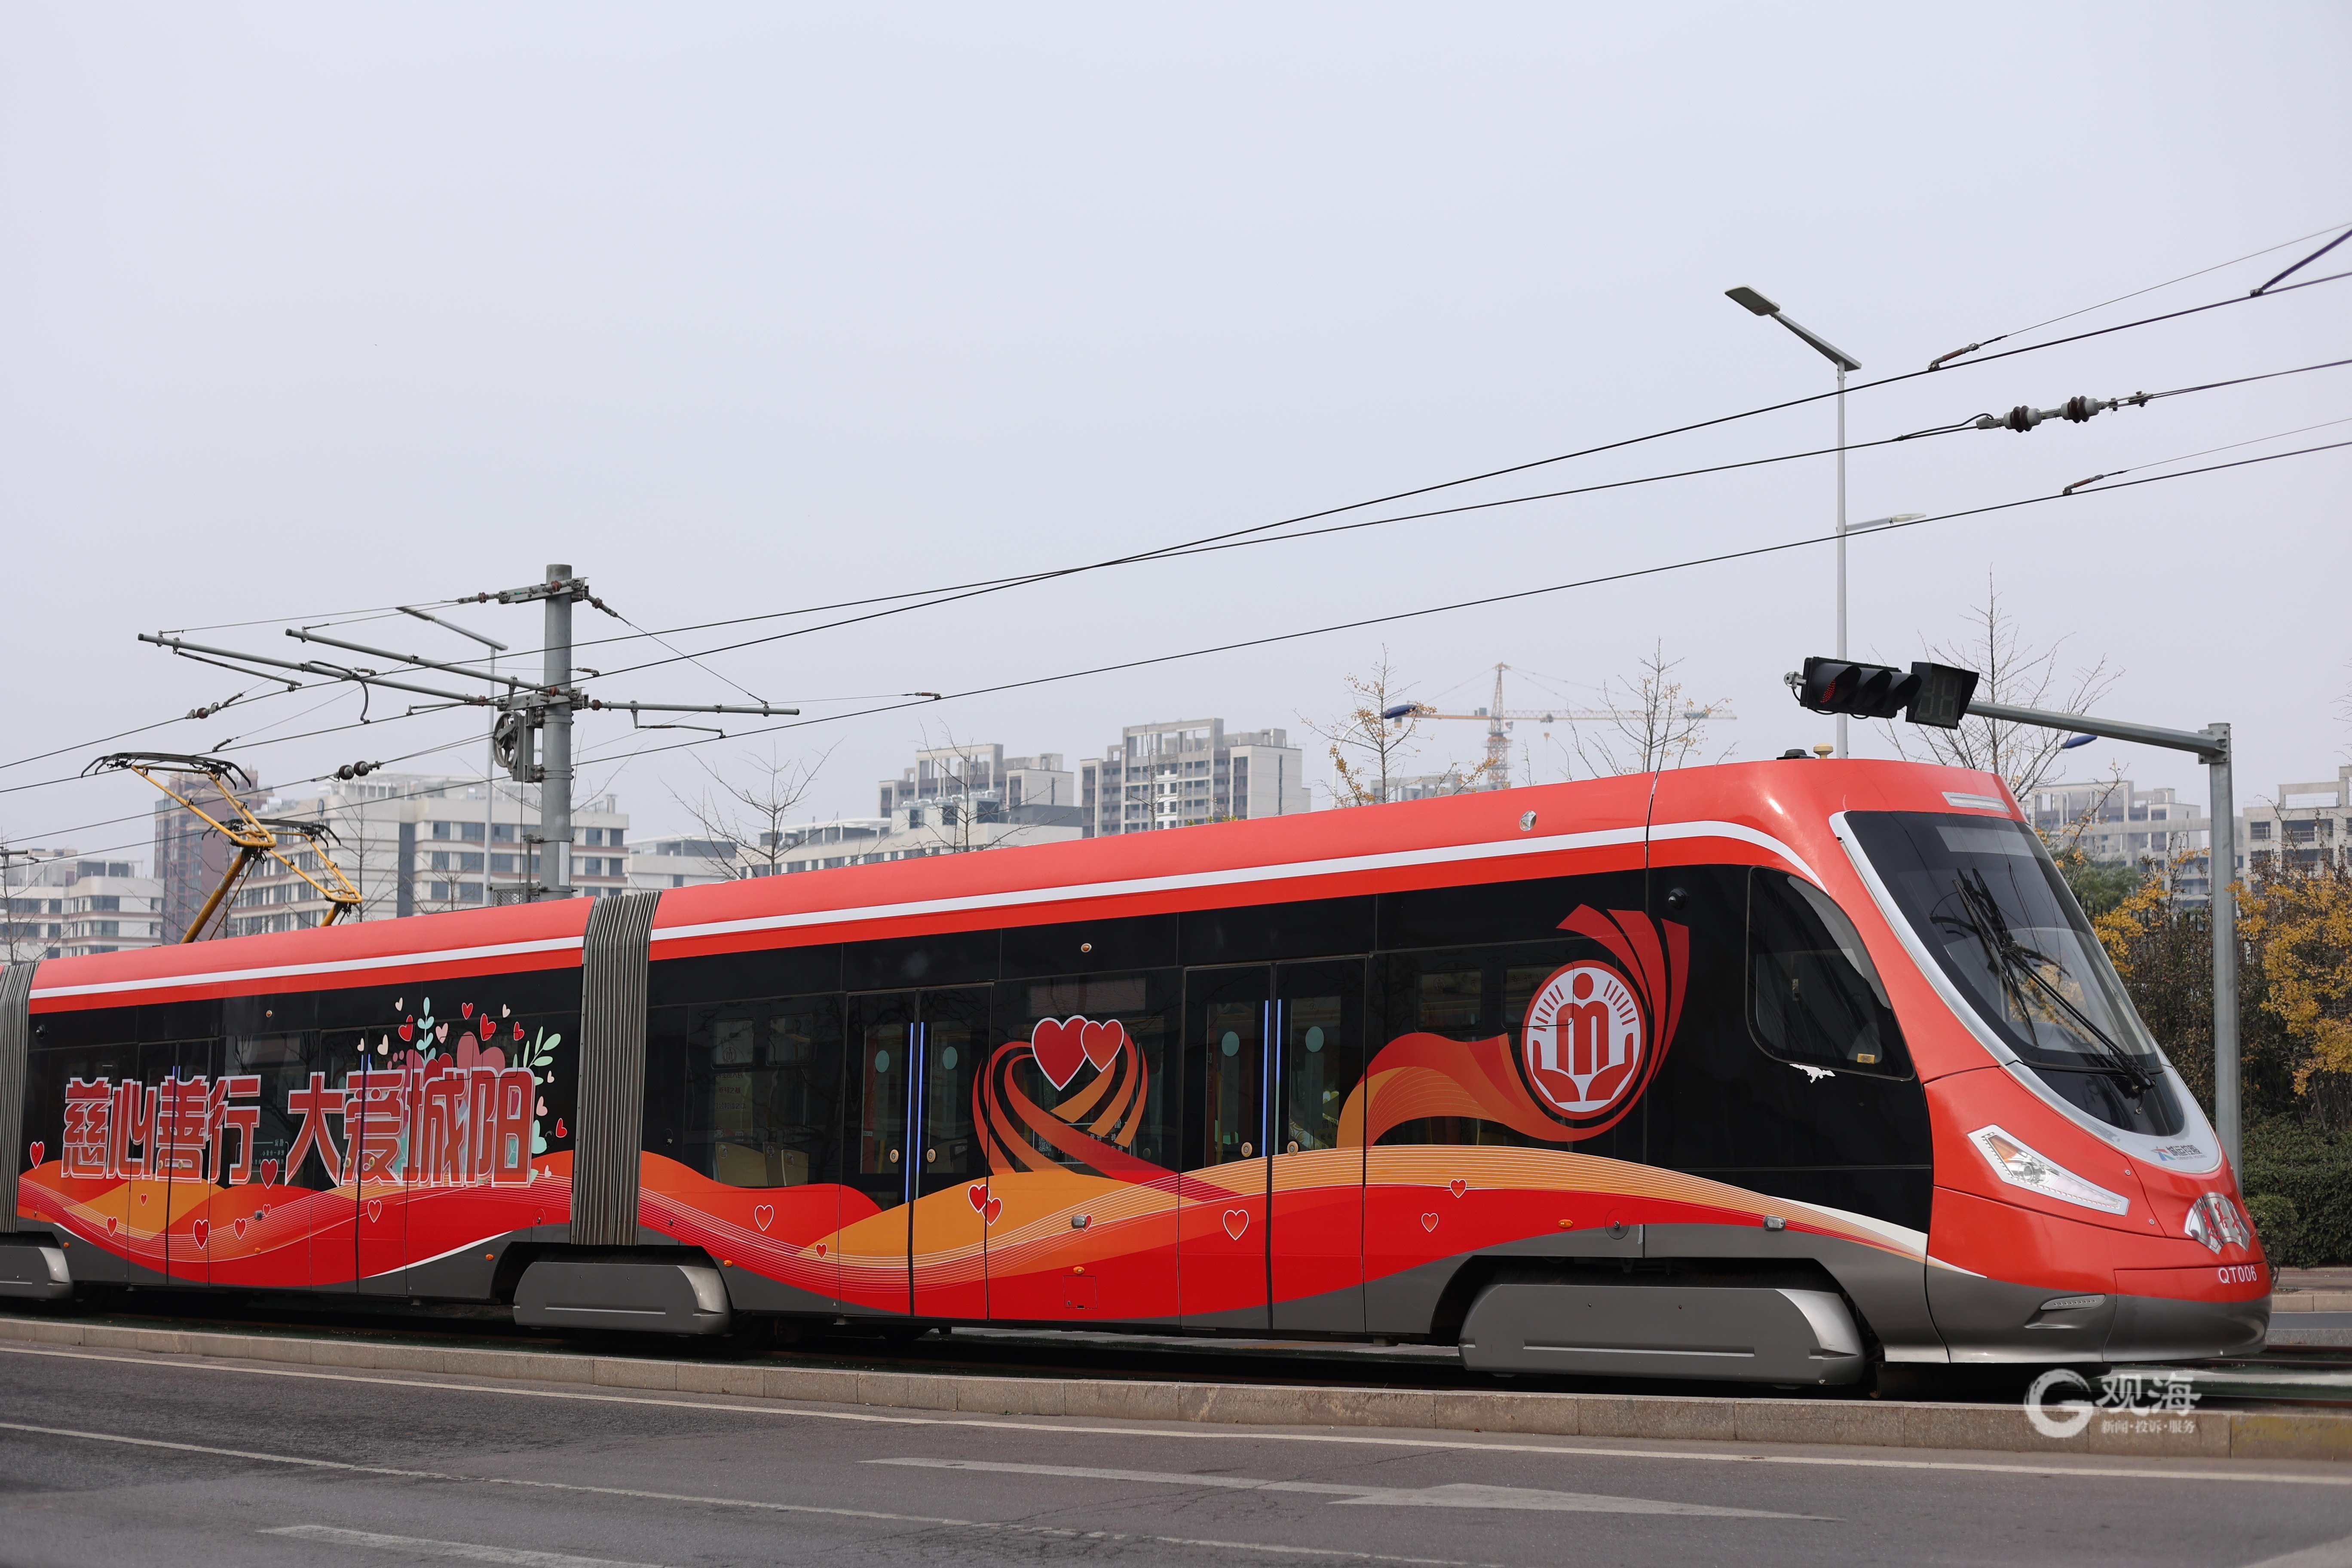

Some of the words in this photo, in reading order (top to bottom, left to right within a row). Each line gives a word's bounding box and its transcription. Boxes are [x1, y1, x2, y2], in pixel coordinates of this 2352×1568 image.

[1511, 973, 1552, 985] 幸福城
[61, 1075, 260, 1185] 慈心善行
[285, 1066, 535, 1187] 大爱城阳
[2166, 1145, 2203, 1156] 城运控股
[2218, 1266, 2257, 1284] QT006
